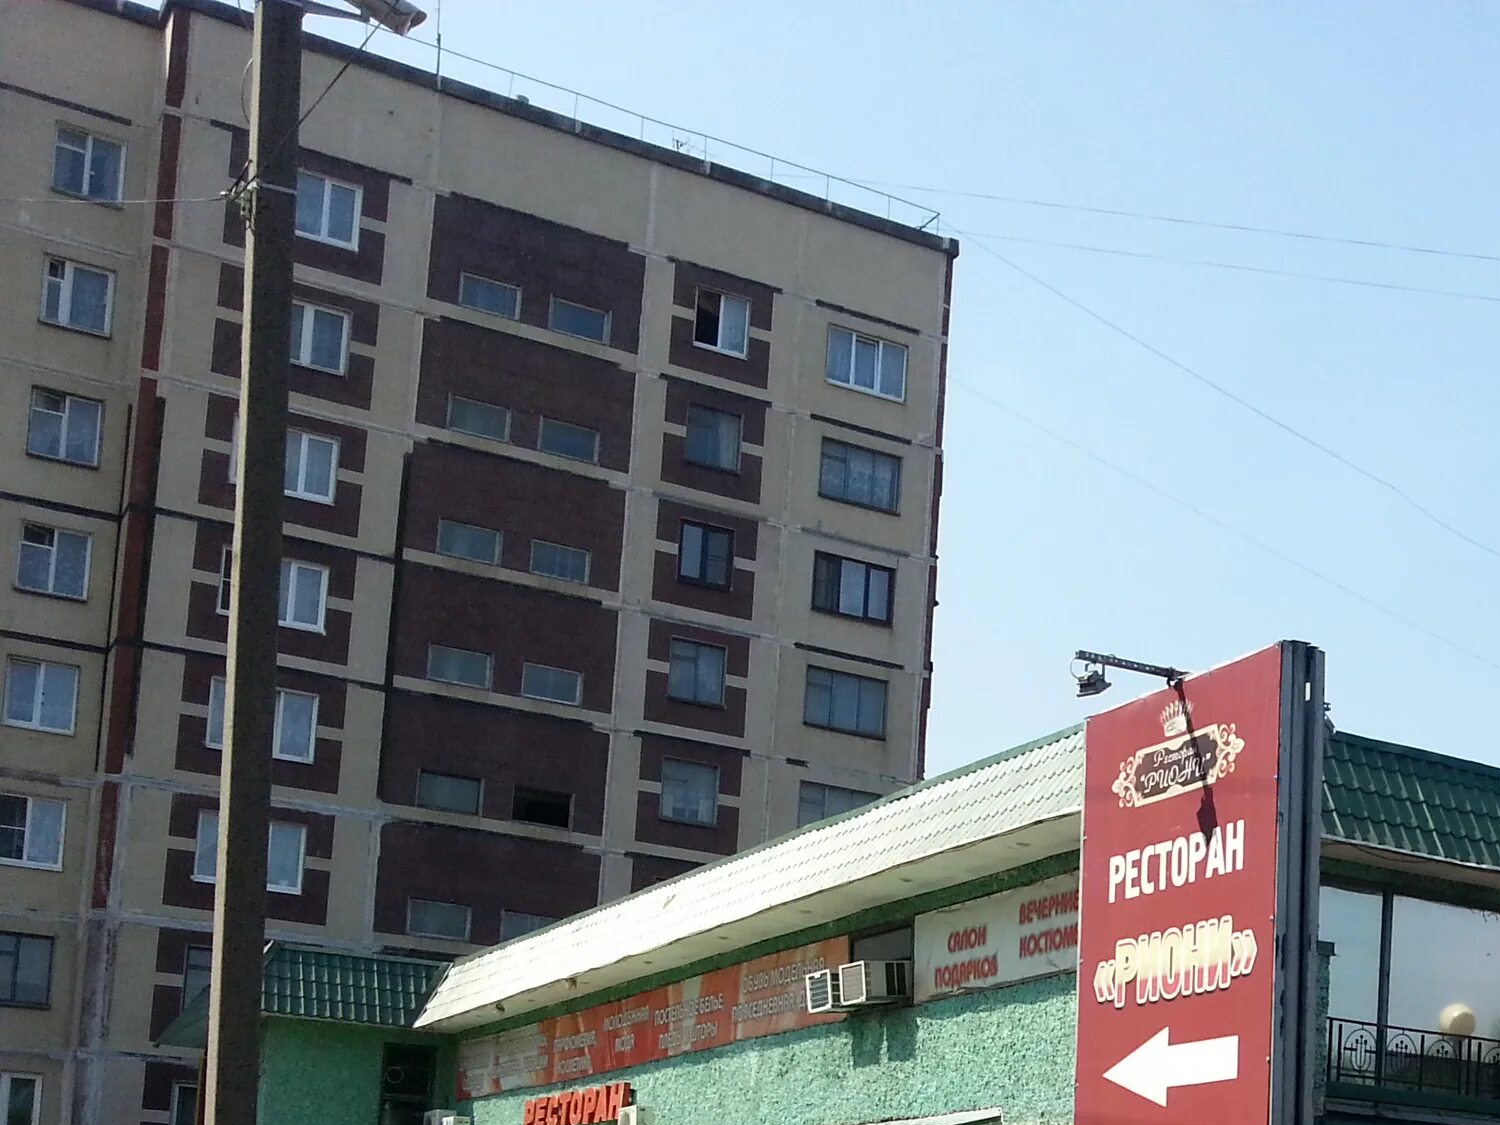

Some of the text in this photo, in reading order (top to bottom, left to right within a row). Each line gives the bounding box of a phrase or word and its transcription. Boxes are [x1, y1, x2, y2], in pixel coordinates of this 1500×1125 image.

[1153, 746, 1200, 767] Рестора
[1108, 819, 1246, 904] РЕСТОРАН
[947, 923, 988, 953] САЛОН
[934, 953, 998, 990] ПОДАРКОВ
[1093, 914, 1258, 1009] «РИОНИ»
